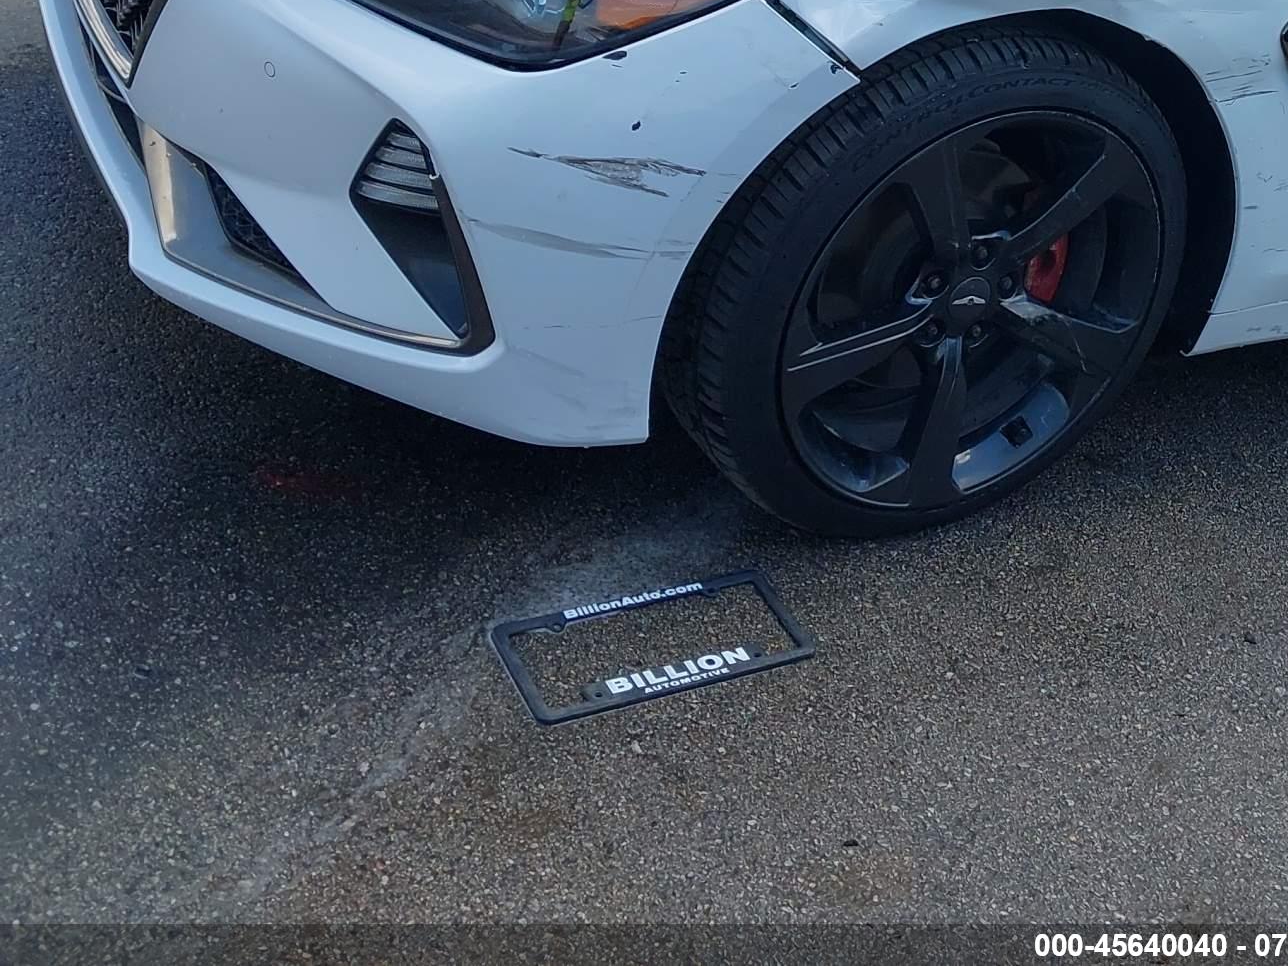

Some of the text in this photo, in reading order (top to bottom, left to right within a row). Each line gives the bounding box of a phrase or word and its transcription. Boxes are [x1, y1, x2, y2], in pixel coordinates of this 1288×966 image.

[563, 582, 703, 620] BillionAuto.com
[605, 647, 751, 695] BILLION
[644, 667, 731, 694] AUTOMOTIVE
